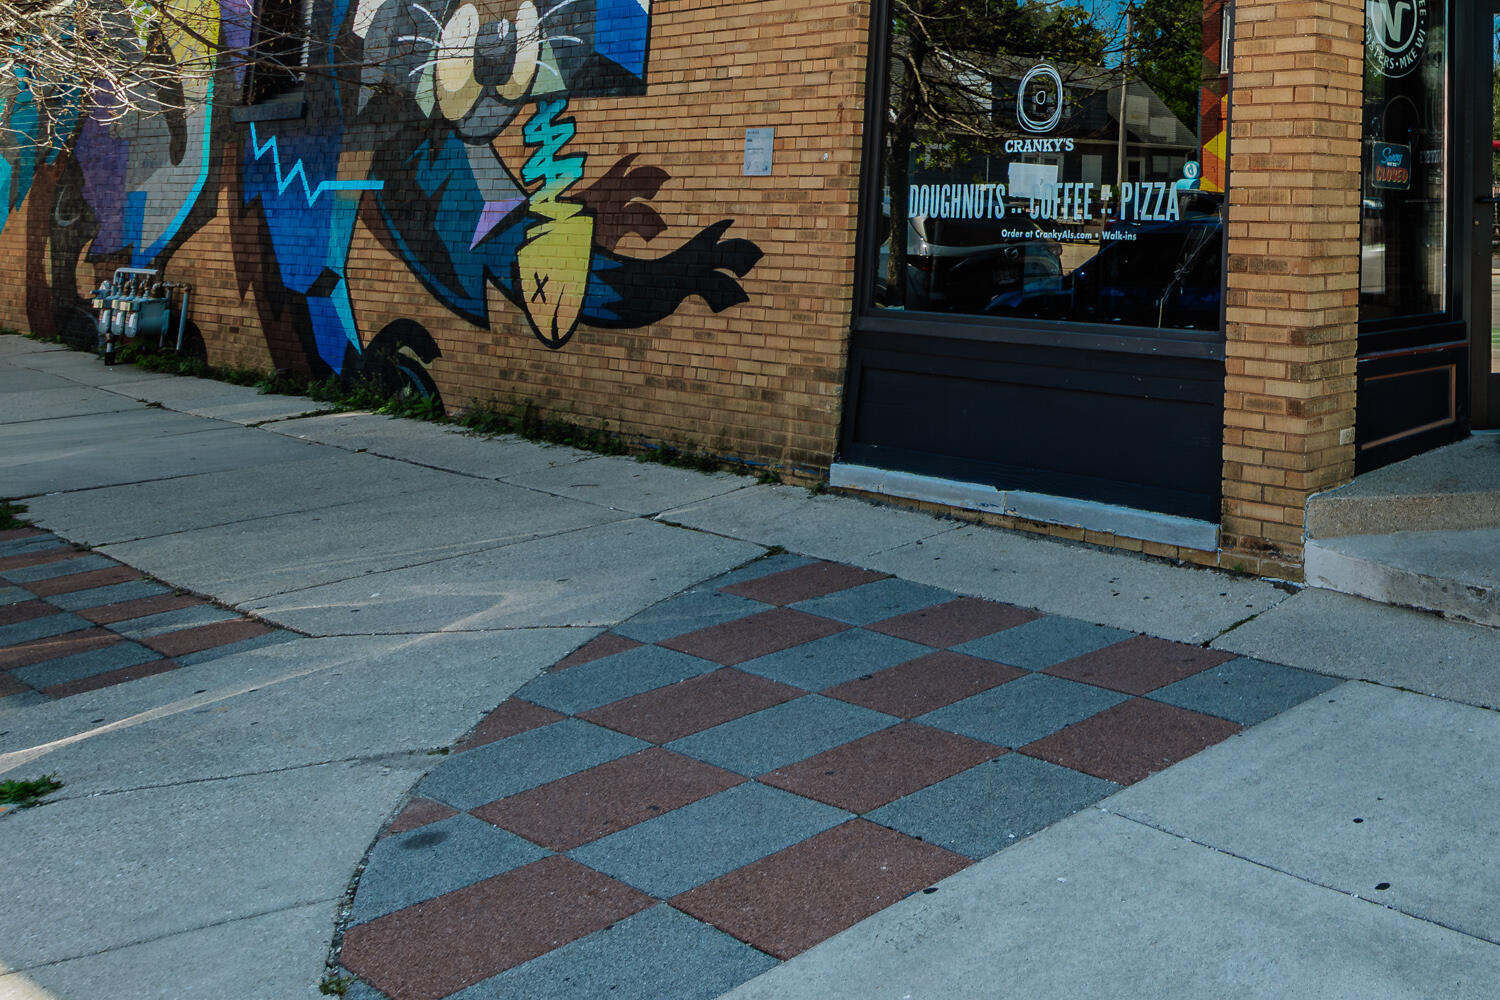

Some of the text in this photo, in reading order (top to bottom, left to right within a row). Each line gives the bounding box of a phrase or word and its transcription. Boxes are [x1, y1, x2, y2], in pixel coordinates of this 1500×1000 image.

[1400, 47, 1418, 69] MKE
[1004, 137, 1075, 153] CRANKY'S
[908, 181, 1180, 221] DOUGHNUTS COFFEE PIZZA
[1001, 229, 1137, 241] Order at CrankyAls.com Walk-ins
